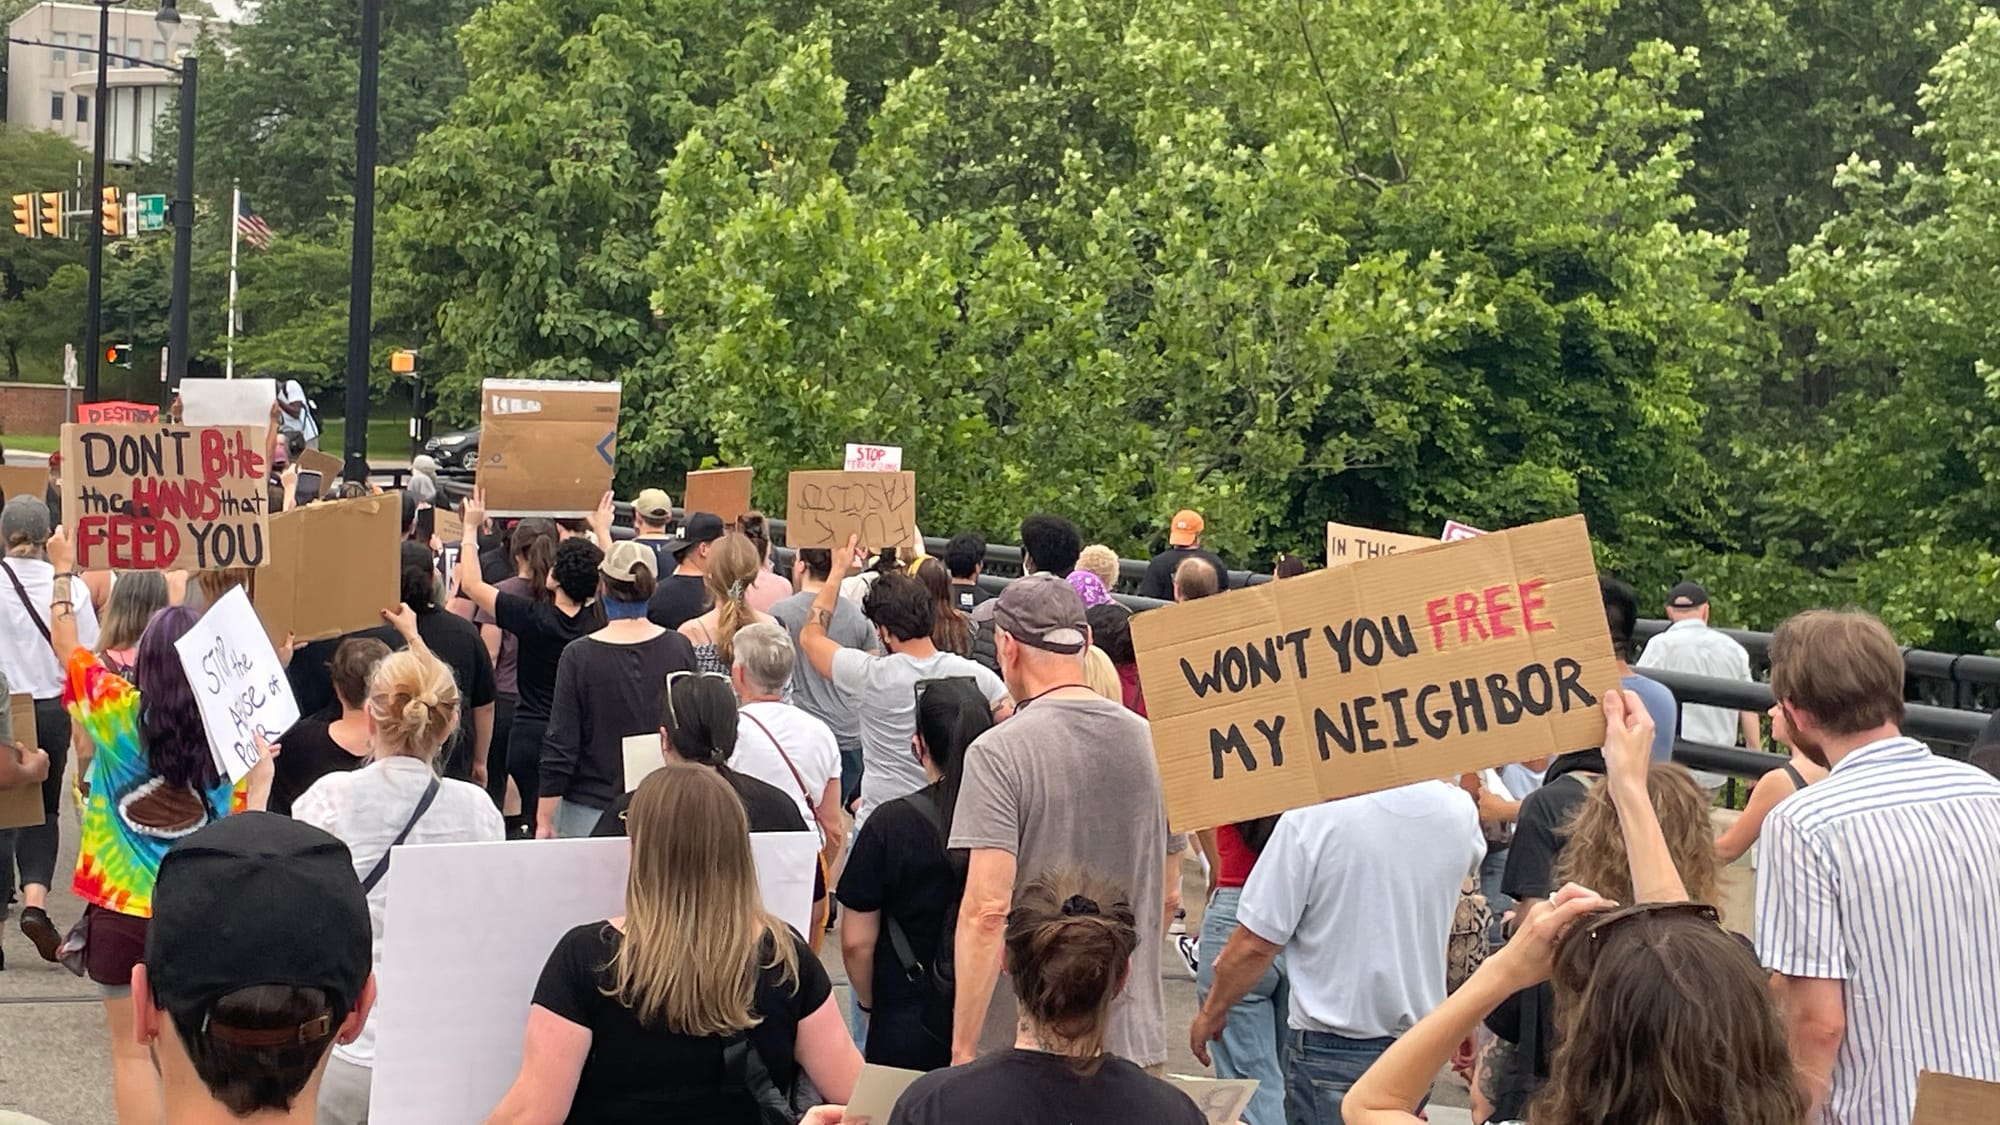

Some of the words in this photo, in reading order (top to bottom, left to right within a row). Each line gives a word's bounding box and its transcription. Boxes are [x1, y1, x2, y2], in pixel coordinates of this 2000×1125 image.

[80, 428, 191, 477] DON'T
[201, 429, 264, 479] Bite
[857, 447, 886, 461] STOP
[78, 485, 126, 514] the
[132, 477, 221, 521] HANDS
[220, 488, 266, 516] that
[77, 516, 180, 569] FEED
[187, 522, 263, 568] YOU
[1332, 537, 1346, 556] IN
[1180, 627, 1313, 698] WON'T
[1323, 614, 1419, 673] YOU
[1426, 578, 1555, 651] FREE
[1209, 715, 1285, 779] MY
[1314, 657, 1597, 760] NEIGHBOR
